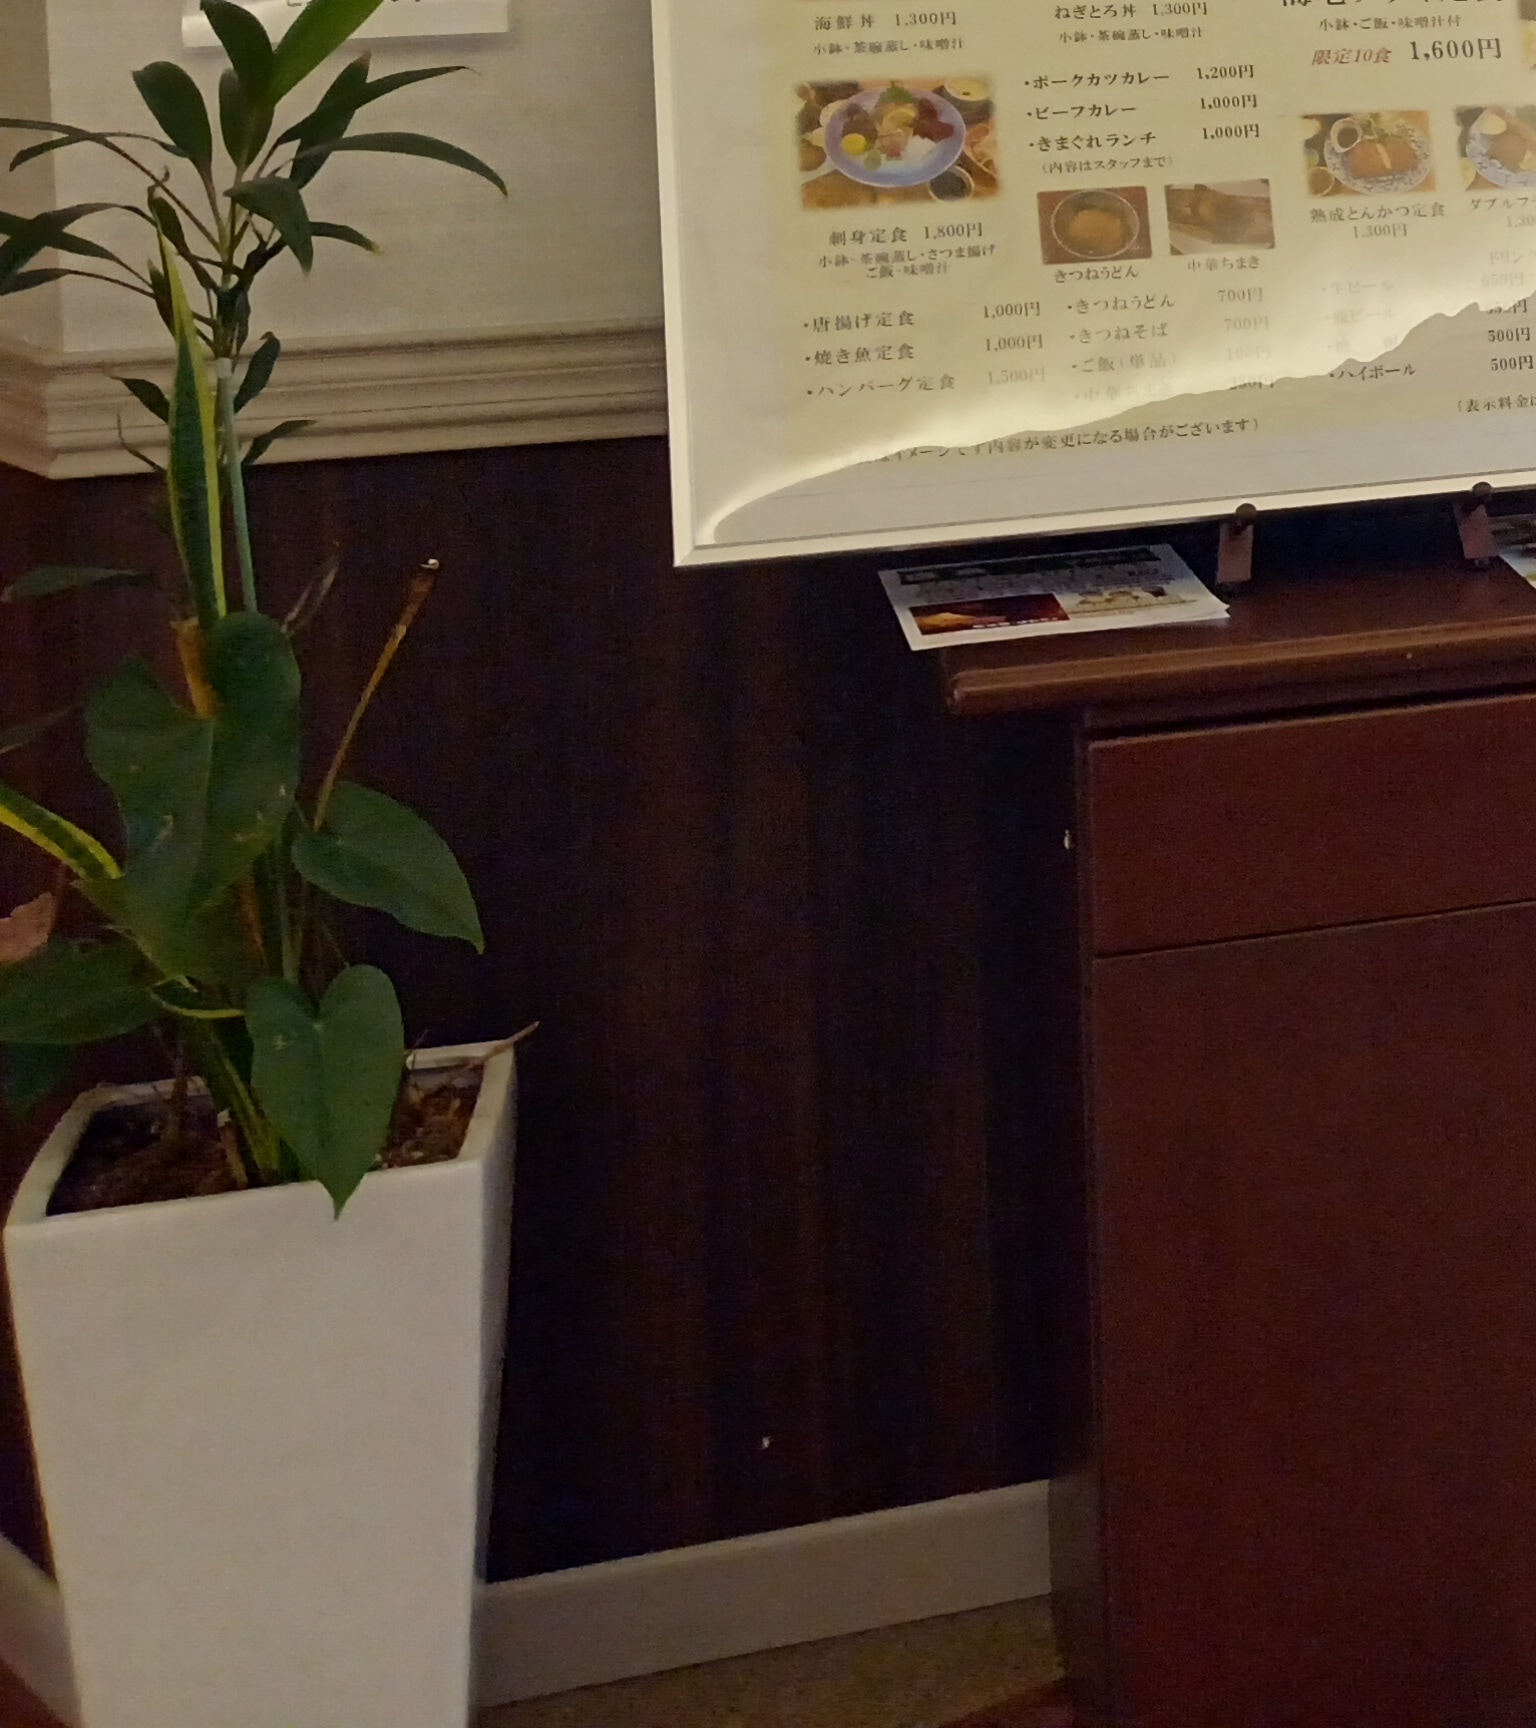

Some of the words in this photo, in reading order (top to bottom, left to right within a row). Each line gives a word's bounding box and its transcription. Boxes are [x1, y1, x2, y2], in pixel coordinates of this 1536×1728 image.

[814, 15, 875, 31] 海鮮丼
[894, 11, 957, 28] 1,300円
[1054, 3, 1137, 20] ねぎとろ丼
[1311, 47, 1392, 66] 限定10食
[1410, 38, 1502, 62] 1,600円
[1309, 202, 1446, 223] 熟成とんかつ定食
[829, 225, 908, 247] 刺身定食
[923, 222, 983, 240] 1,800円
[1054, 264, 1139, 283] きつねうどん
[1487, 327, 1531, 343] 500円
[1490, 355, 1534, 371] 500円
